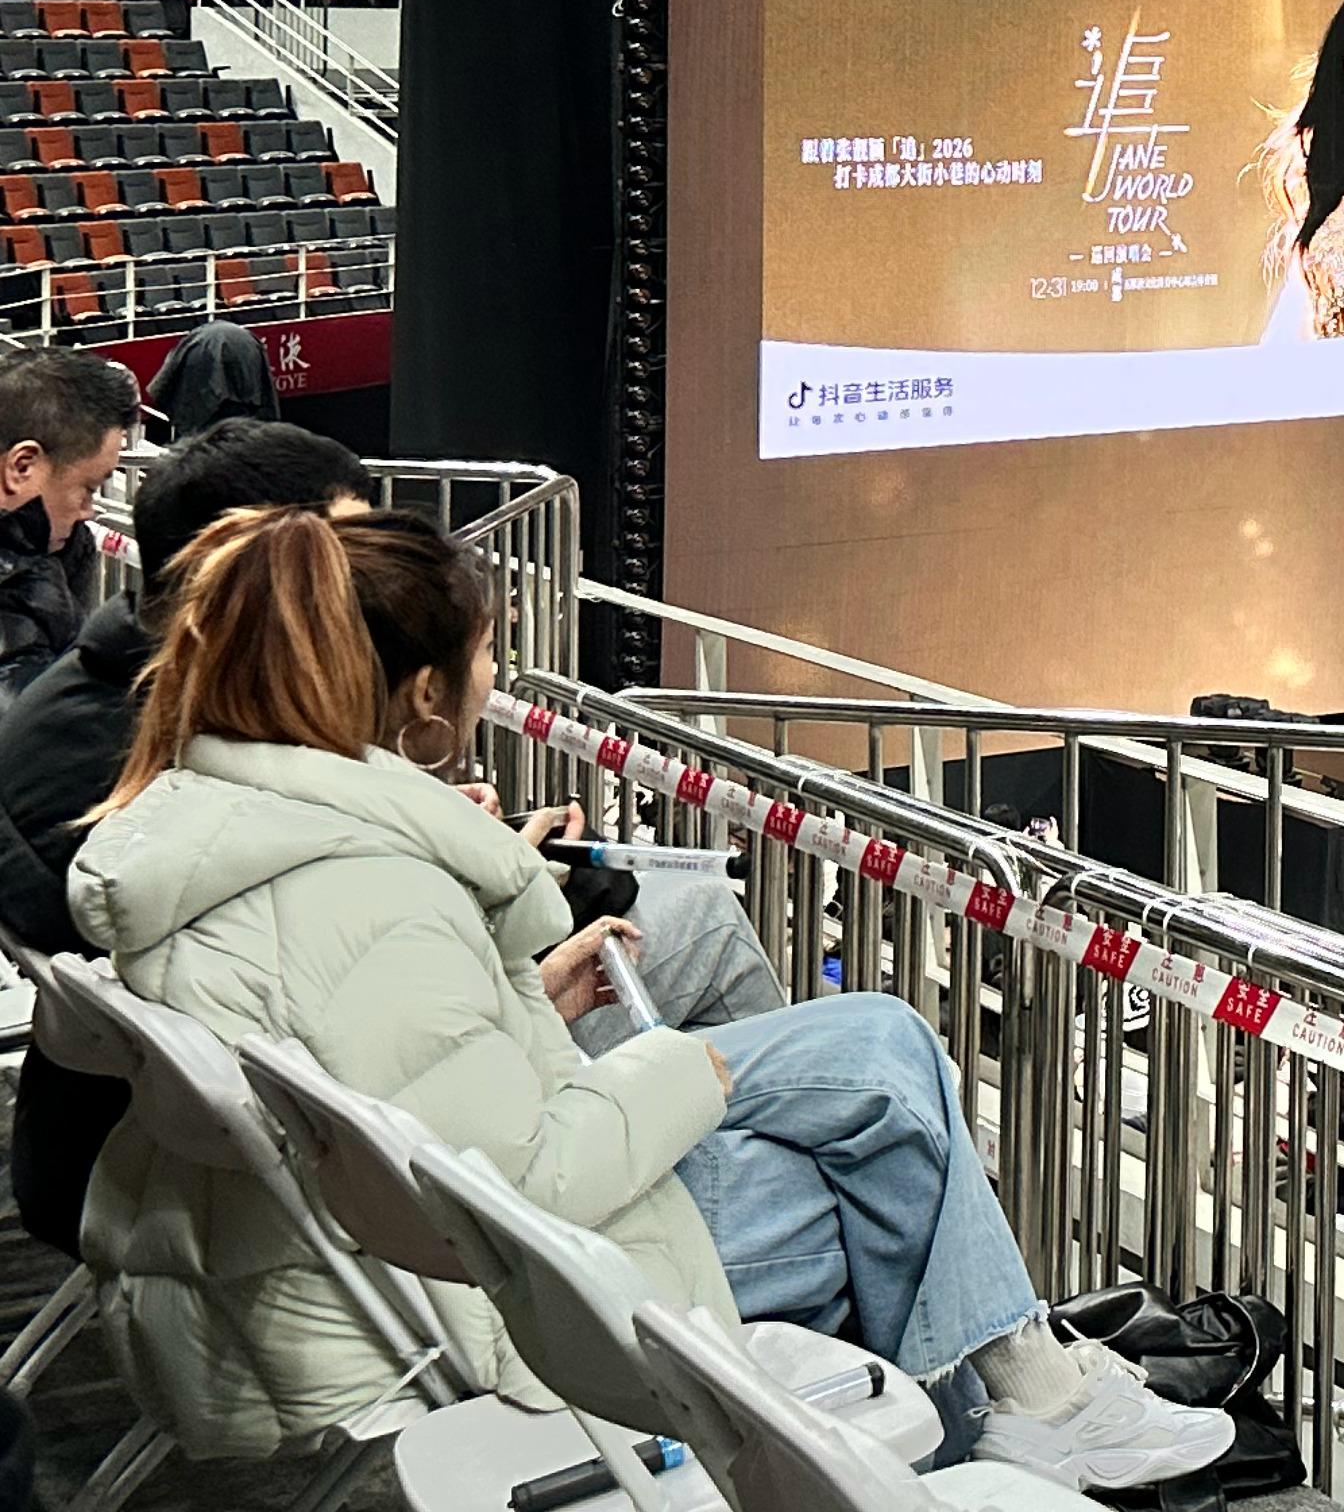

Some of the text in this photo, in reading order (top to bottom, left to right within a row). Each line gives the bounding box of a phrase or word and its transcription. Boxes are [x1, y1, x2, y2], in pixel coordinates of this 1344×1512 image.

[1063, 8, 1190, 148] 追
[1113, 172, 1193, 204] WORLD
[1107, 204, 1171, 235] TOUR
[819, 377, 953, 406] 抖音生活服务
[867, 855, 892, 875] SAFE
[914, 873, 951, 898] CAUTION
[974, 897, 1002, 919] SAFE
[1026, 918, 1069, 945] CAUTION
[1093, 944, 1125, 969] SAFE
[1152, 967, 1199, 998] CAUTION
[1227, 997, 1263, 1024] SAFE
